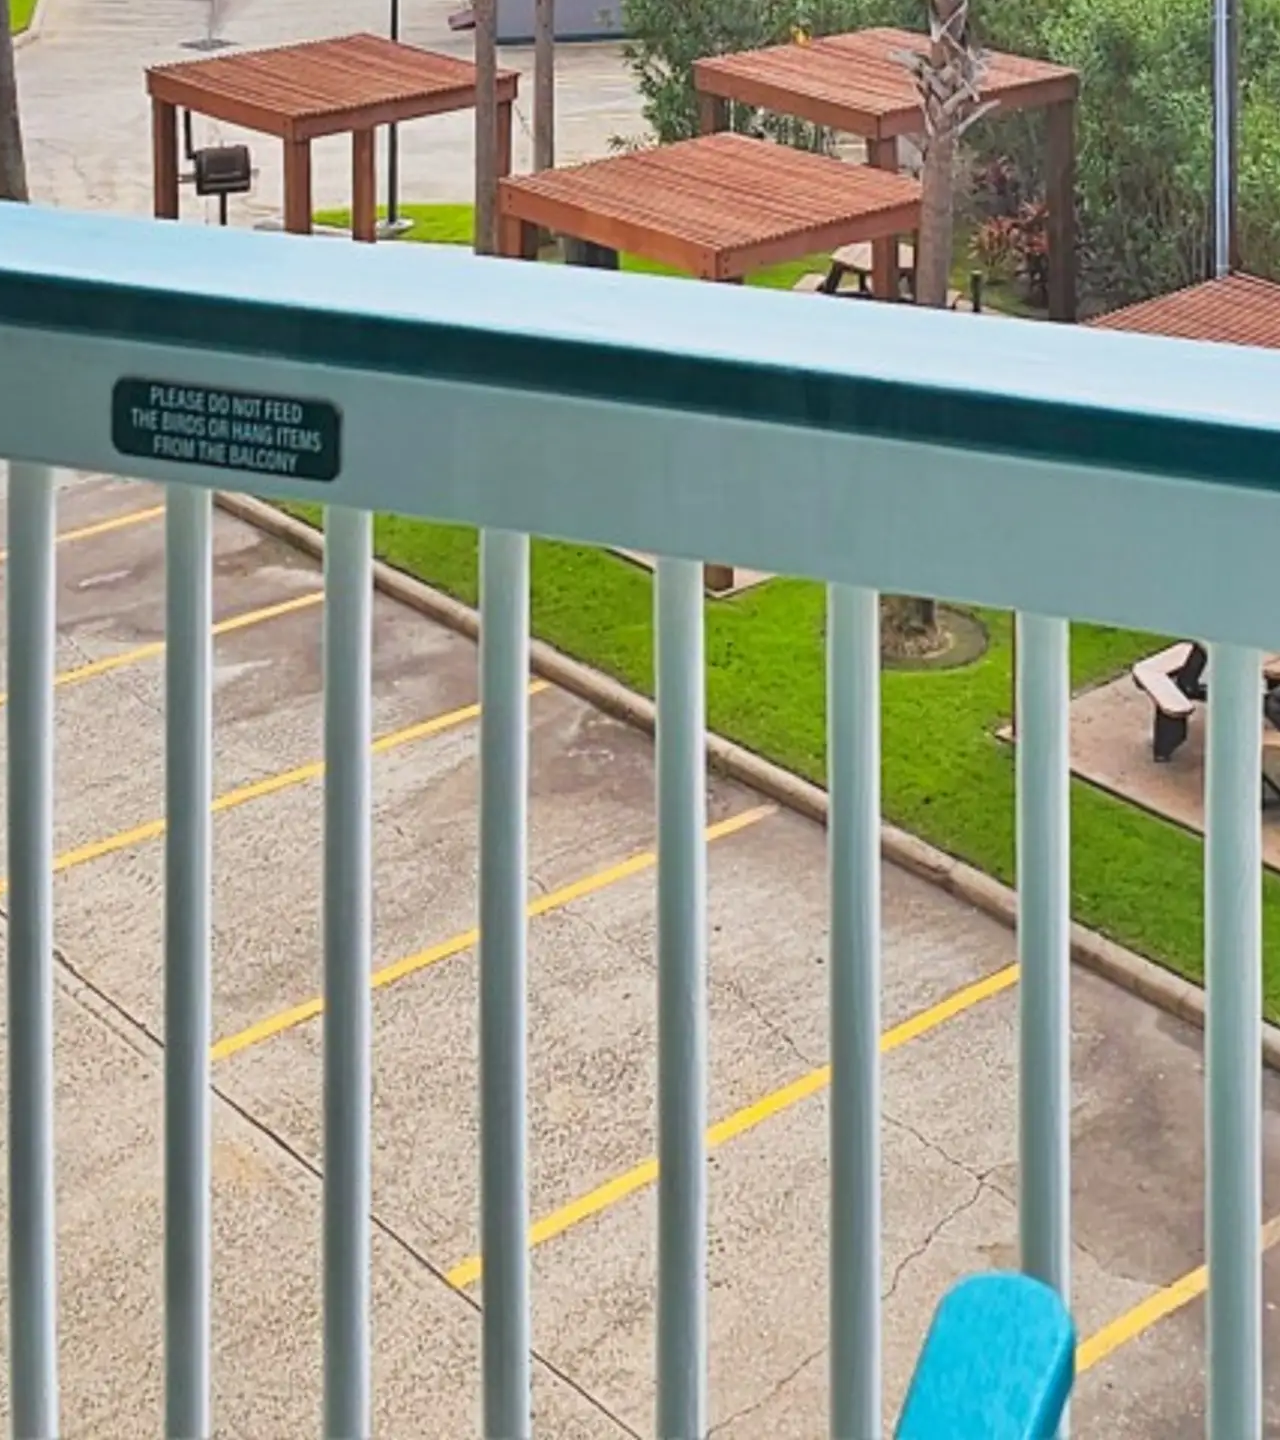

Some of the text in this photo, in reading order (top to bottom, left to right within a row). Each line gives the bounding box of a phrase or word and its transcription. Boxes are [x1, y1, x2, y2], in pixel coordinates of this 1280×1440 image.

[150, 385, 303, 425] PLEASE DO NOT FEED
[131, 408, 322, 453] THE BIRDS OR HANG ITEMS
[153, 434, 299, 474] FROM THE BALCONY
